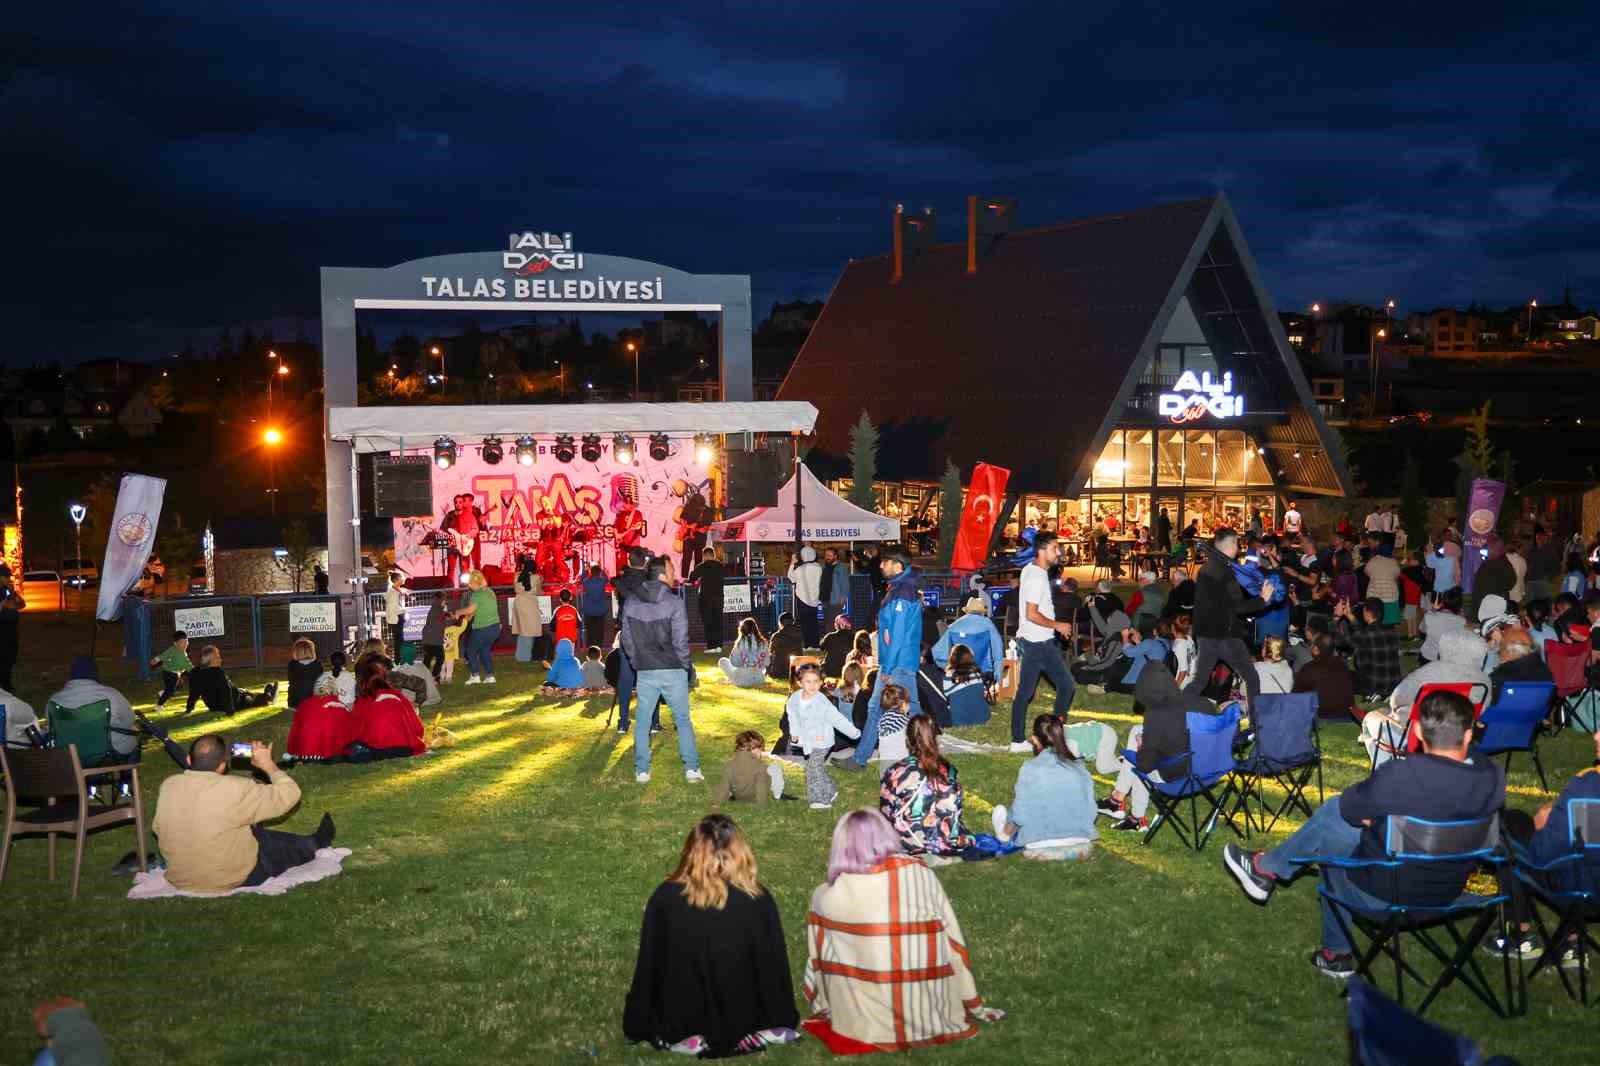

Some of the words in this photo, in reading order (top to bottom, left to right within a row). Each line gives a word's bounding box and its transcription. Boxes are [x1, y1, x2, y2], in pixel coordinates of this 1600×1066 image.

[421, 276, 506, 298] TALAS
[514, 276, 663, 300] BELEDİYESİ
[815, 527, 861, 537] BELEDİYESİ
[185, 621, 214, 630] ZABITA
